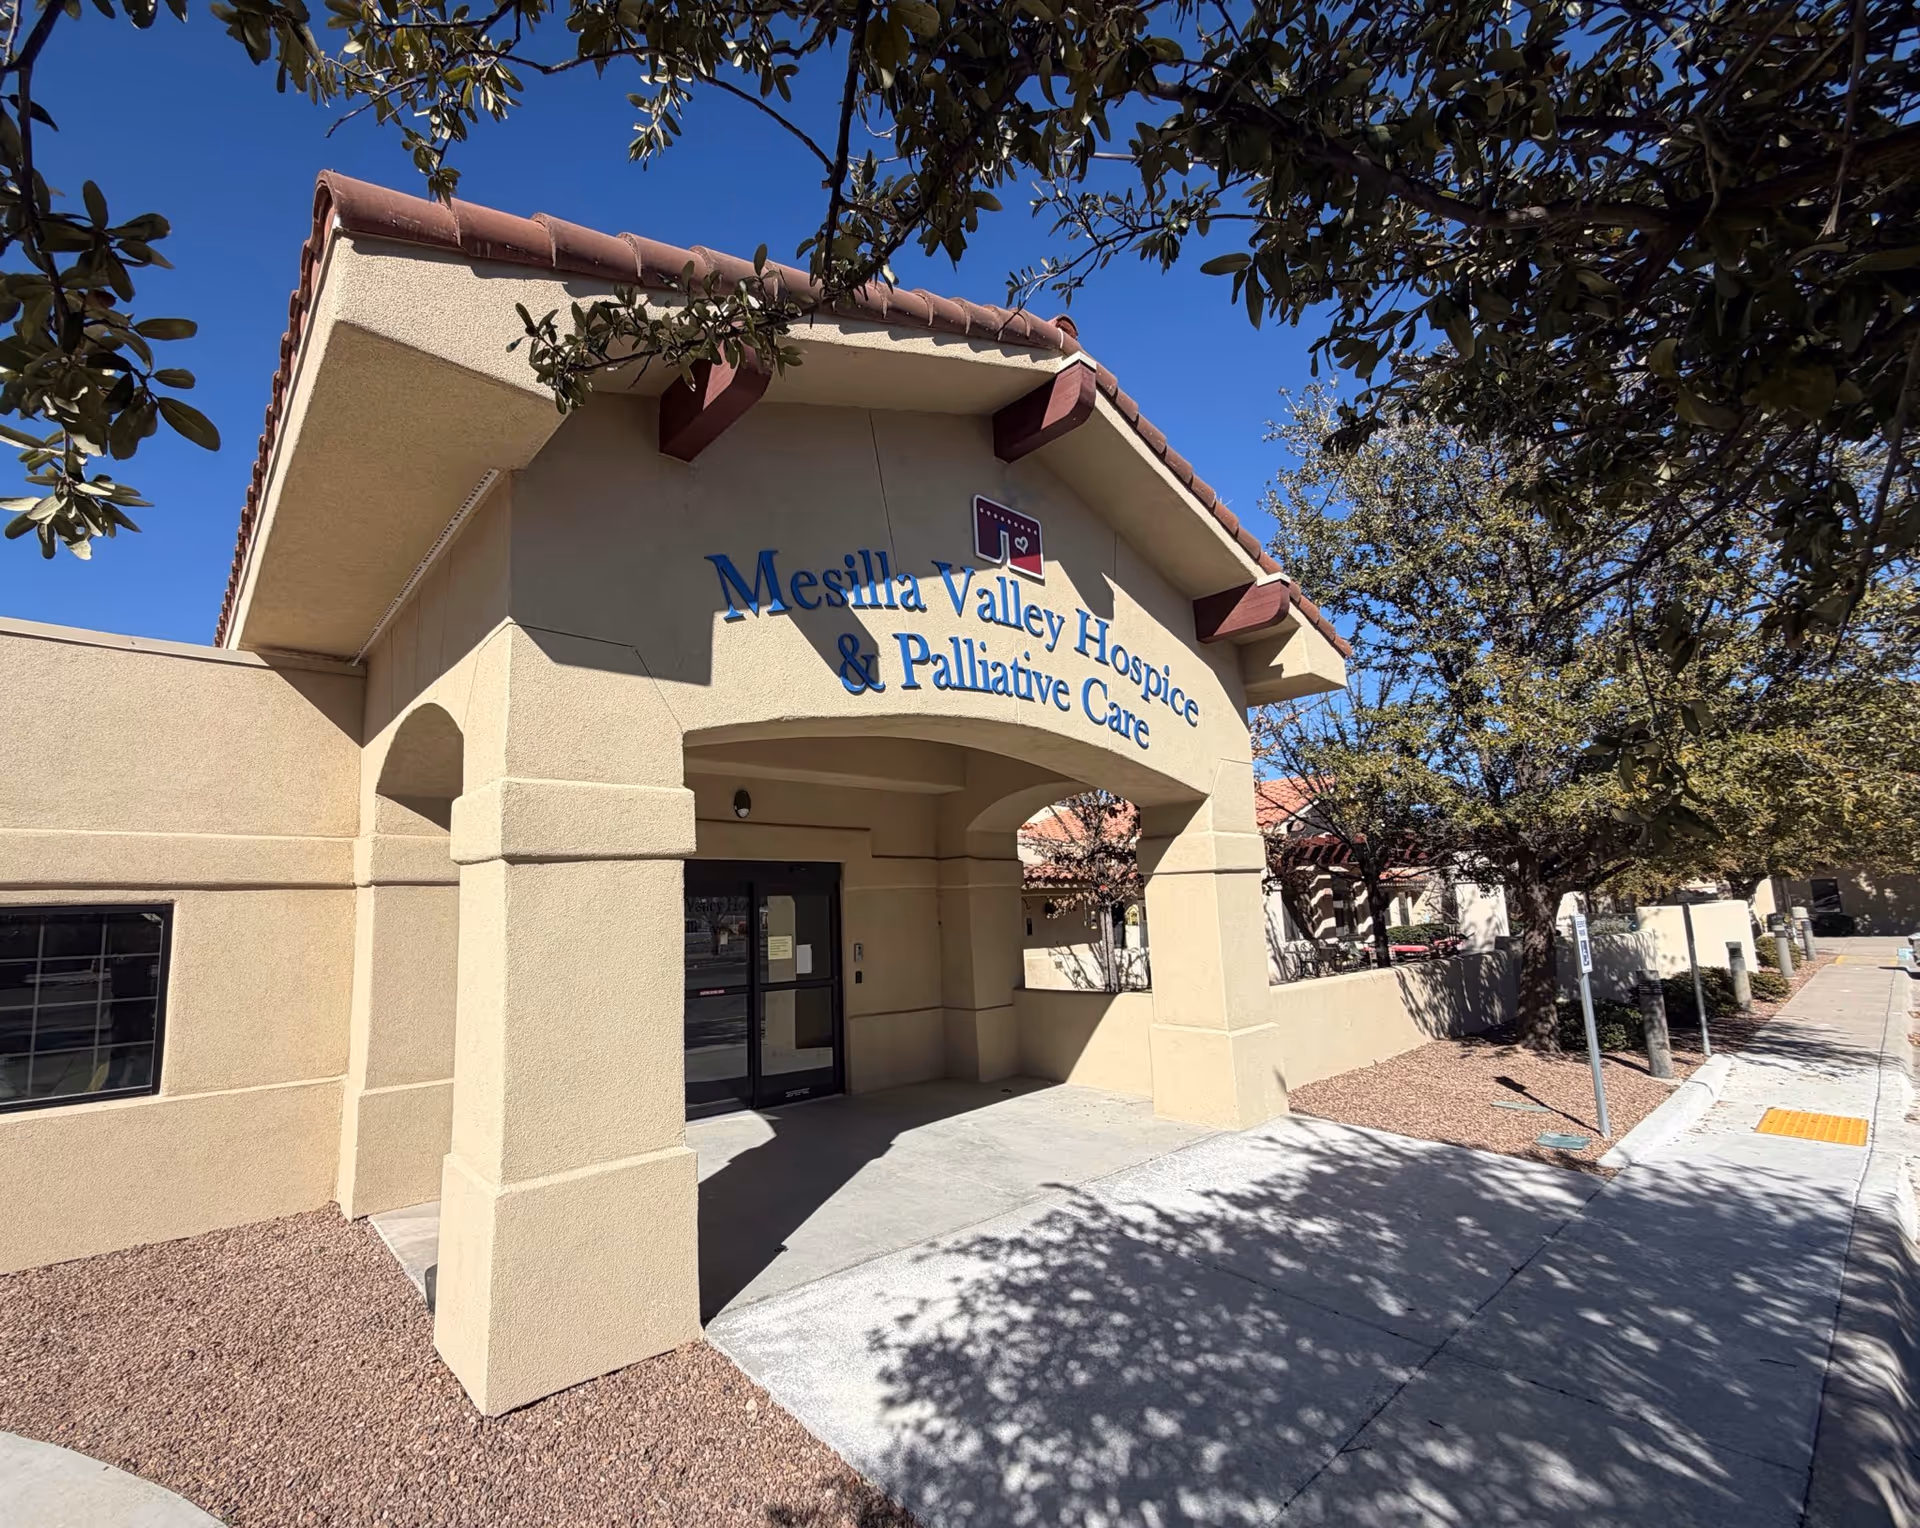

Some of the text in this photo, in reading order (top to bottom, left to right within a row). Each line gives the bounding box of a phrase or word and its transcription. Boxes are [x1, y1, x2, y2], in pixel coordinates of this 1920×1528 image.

[704, 548, 1200, 727] Mesilla Valley Hospice
[838, 633, 1150, 750] & Palliative Care
